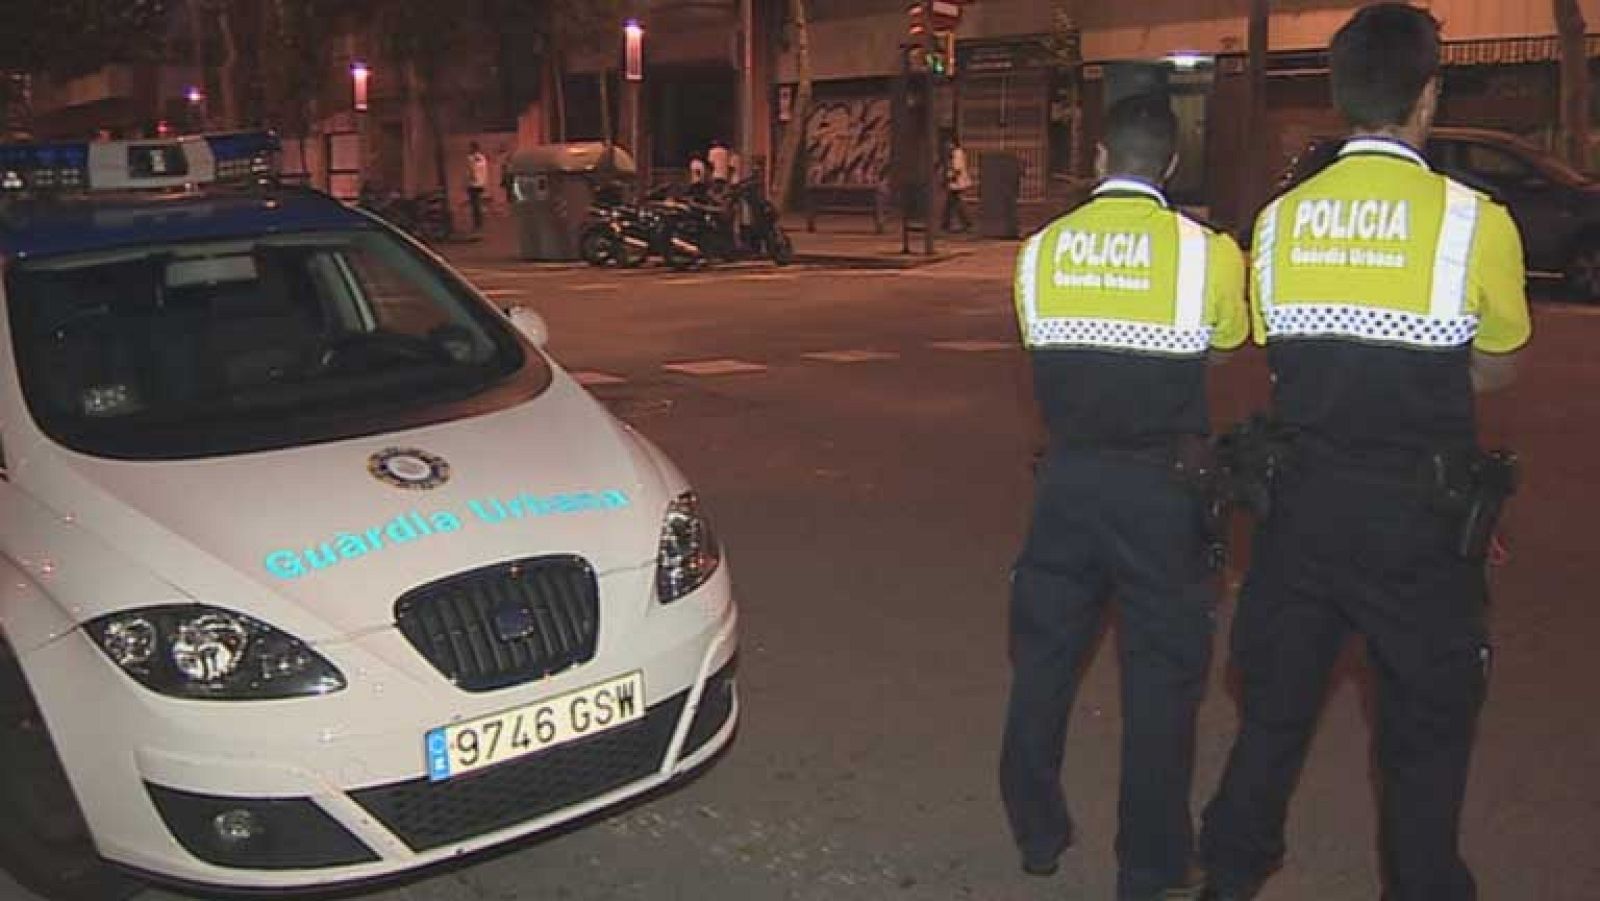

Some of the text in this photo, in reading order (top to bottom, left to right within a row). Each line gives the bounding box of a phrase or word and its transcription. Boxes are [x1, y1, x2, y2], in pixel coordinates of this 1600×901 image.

[1294, 199, 1409, 240] POLICIA
[1054, 229, 1152, 267] POLICIA
[466, 488, 630, 525] Urbana
[456, 679, 634, 766] 9746 GSW
